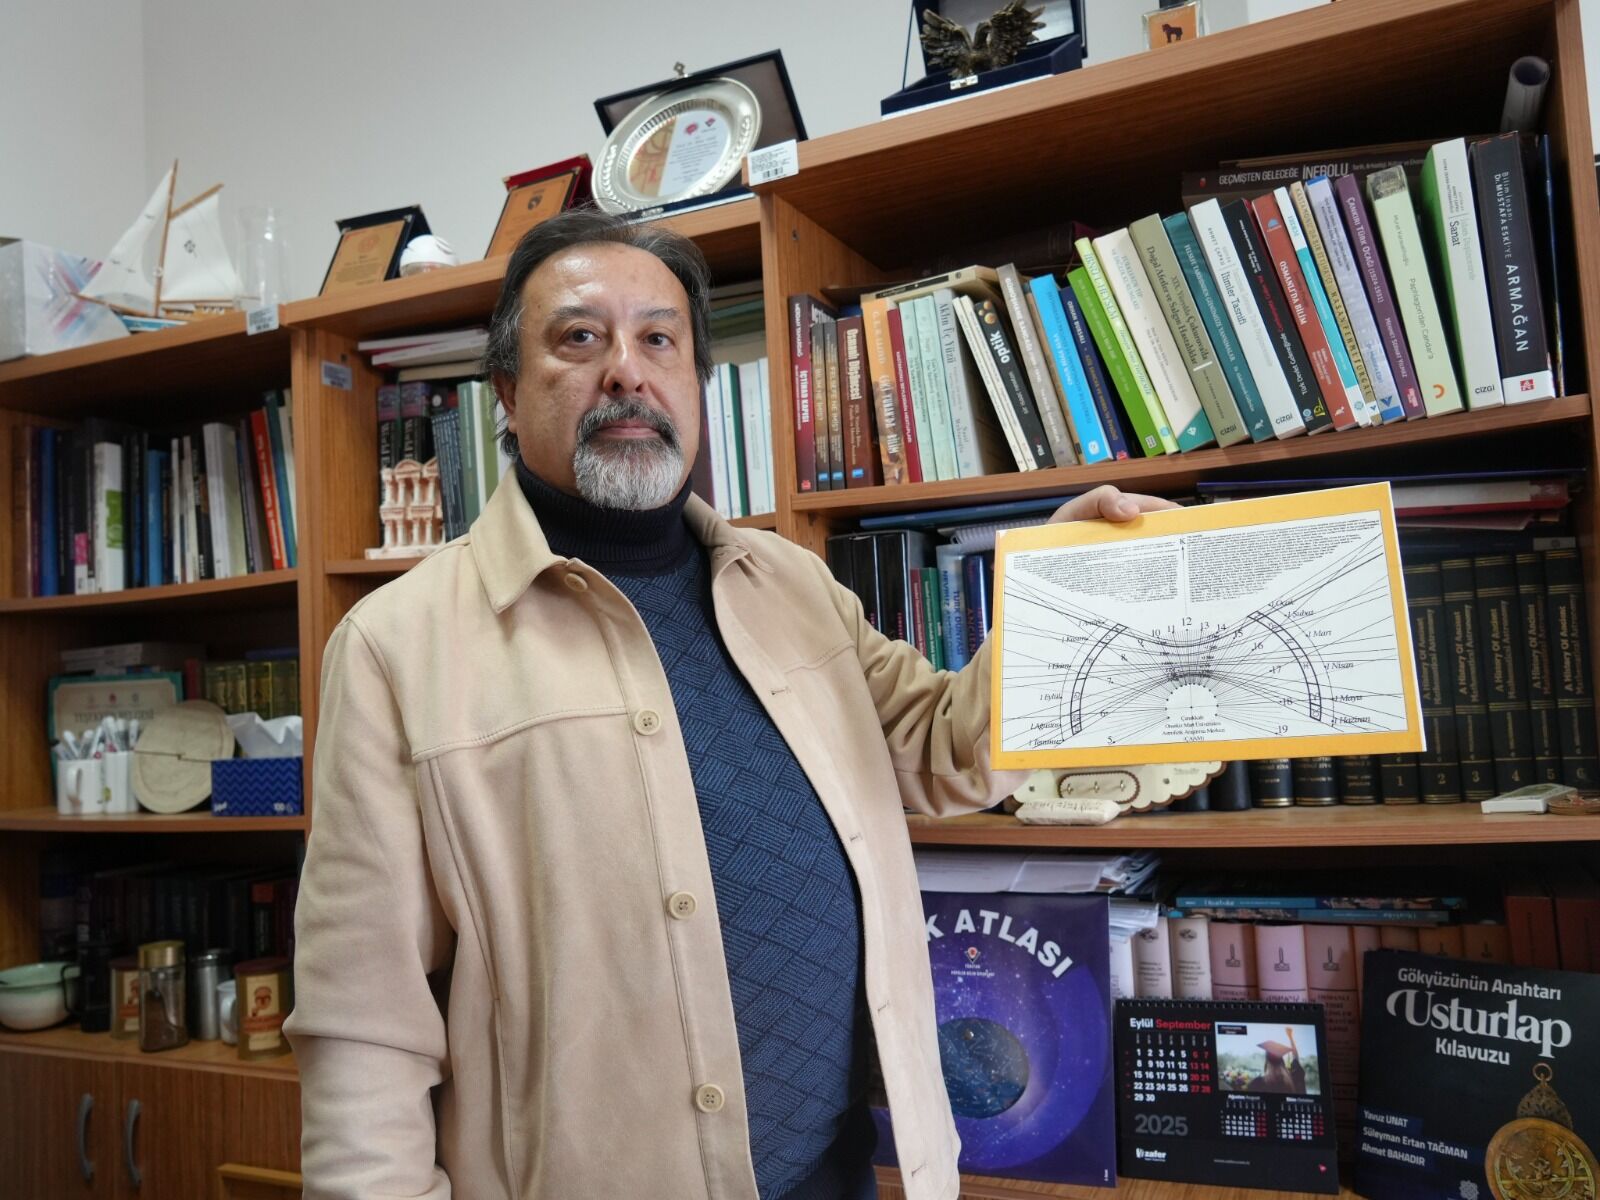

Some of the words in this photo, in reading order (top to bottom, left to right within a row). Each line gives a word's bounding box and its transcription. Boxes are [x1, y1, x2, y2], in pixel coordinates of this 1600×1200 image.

[1302, 163, 1348, 180] İNEBOLU
[1355, 224, 1369, 245] TÜRK
[1449, 220, 1461, 246] Sanat
[1144, 244, 1162, 269] Doğal
[1154, 267, 1171, 292] Afetler
[1164, 291, 1173, 302] ve
[1220, 270, 1238, 297] İlimler
[1230, 297, 1248, 325] Tasnifi
[1505, 262, 1532, 351] ARMAĞAN
[938, 302, 953, 325] Aklın
[1066, 299, 1078, 320] ORHAN
[1073, 320, 1086, 344] BURSALI
[1293, 302, 1309, 325] BİLİM
[845, 328, 861, 359] Osmanlı
[987, 329, 1012, 365] optik
[846, 360, 864, 400] Düşüncesi
[801, 399, 810, 422] KAPISI
[830, 400, 838, 412] NE
[878, 374, 893, 391] ESKİ
[886, 433, 902, 453] BİLİM
[1152, 629, 1160, 637] 10
[1168, 625, 1175, 633] 11
[1182, 617, 1192, 626] 12
[1201, 622, 1209, 631] 13
[1278, 725, 1288, 733] 19
[1437, 774, 1446, 785] 2
[1512, 768, 1520, 782] 4
[954, 909, 1073, 978] ATLASI
[1398, 968, 1488, 992] Gökyüzünün
[1492, 979, 1561, 1000] Anahtarı
[1130, 1017, 1154, 1030] Eylül
[1155, 1017, 1211, 1031] September
[1386, 989, 1572, 1059] Usturlap
[1436, 1037, 1510, 1065] Kılavuzu
[1134, 1070, 1143, 1079] 15
[1145, 1071, 1154, 1079] 16
[1155, 1071, 1165, 1080] 17
[1167, 1072, 1176, 1080] 18
[1178, 1072, 1188, 1081] 19
[1155, 1060, 1164, 1068] 10
[1166, 1060, 1175, 1069] 11
[1178, 1061, 1187, 1069] 12
[1134, 1082, 1143, 1090] 22
[1144, 1082, 1155, 1090] 23
[1155, 1083, 1165, 1091] 24
[1167, 1083, 1177, 1092] 25
[1178, 1084, 1188, 1092] 26
[1134, 1093, 1144, 1101] 29
[1145, 1094, 1155, 1102] 30
[1134, 1114, 1188, 1136] 2025
[1363, 1110, 1385, 1123] Yavuz
[1386, 1115, 1408, 1128] UNAT
[1363, 1126, 1401, 1142] Süleyman
[1402, 1136, 1426, 1150] Ertan
[1427, 1141, 1468, 1159] TAĞMAN
[1362, 1142, 1386, 1157] Ahmet
[1387, 1149, 1426, 1167] BAHADIR
